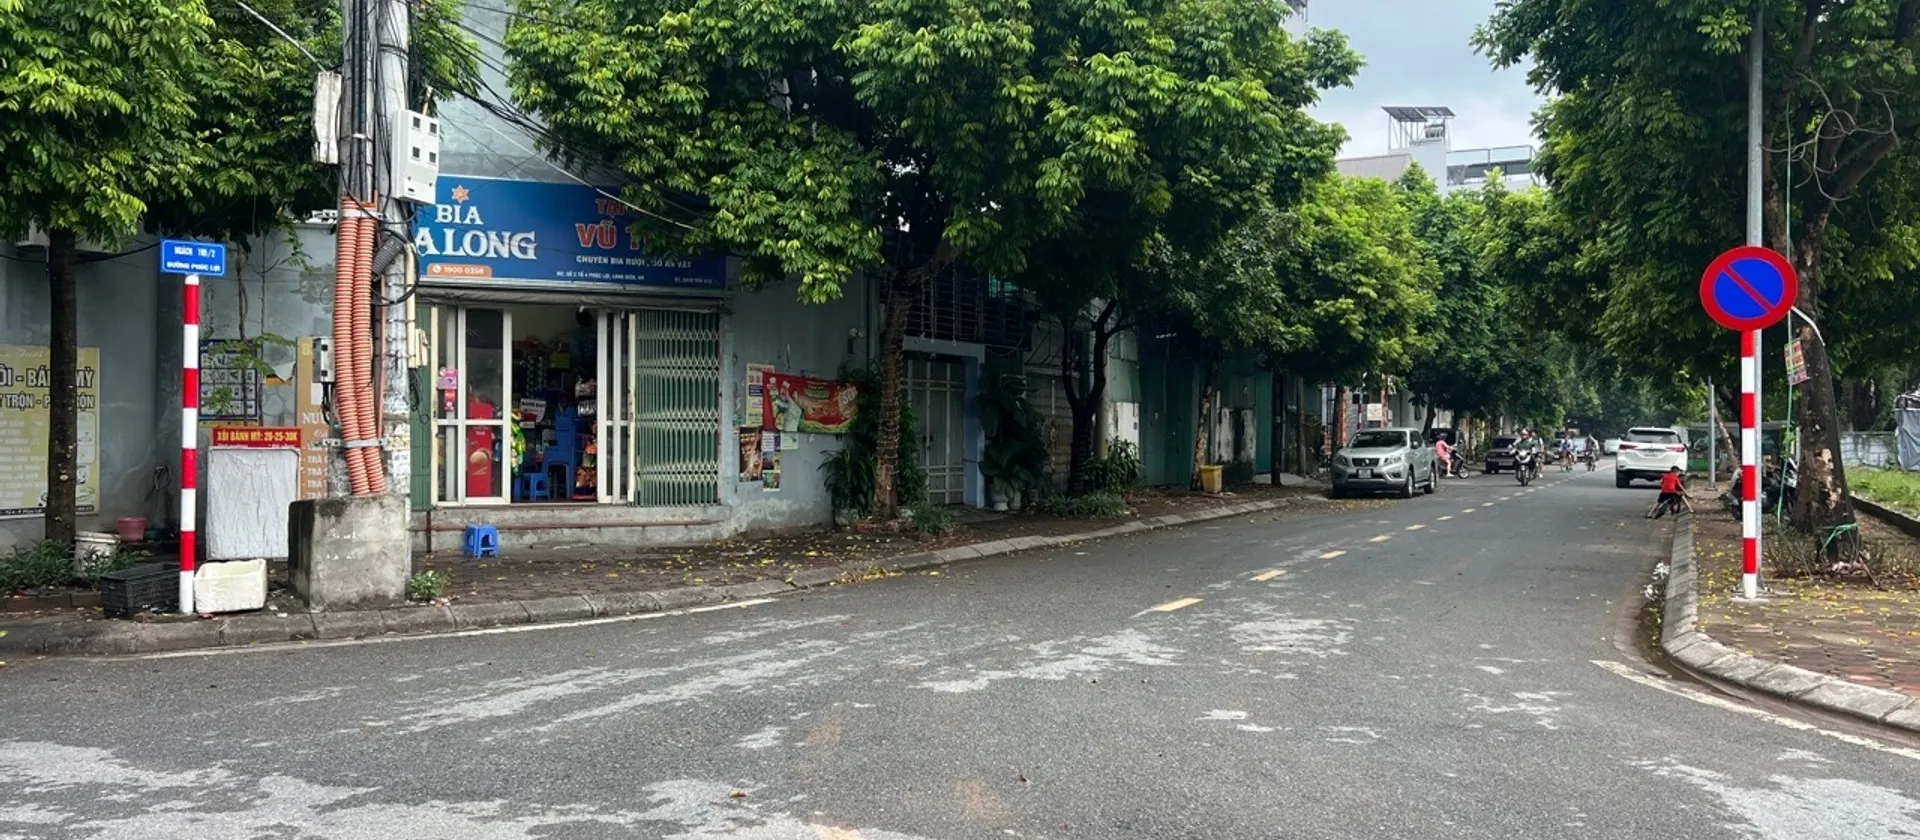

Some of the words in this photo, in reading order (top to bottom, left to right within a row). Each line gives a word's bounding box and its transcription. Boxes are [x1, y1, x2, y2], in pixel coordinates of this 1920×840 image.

[435, 204, 484, 225] BIA
[441, 228, 537, 260] LONG
[575, 220, 617, 249] VŨ
[610, 257, 624, 265] BIA
[6, 391, 34, 411] TRỘN
[230, 430, 249, 441] BÁNH
